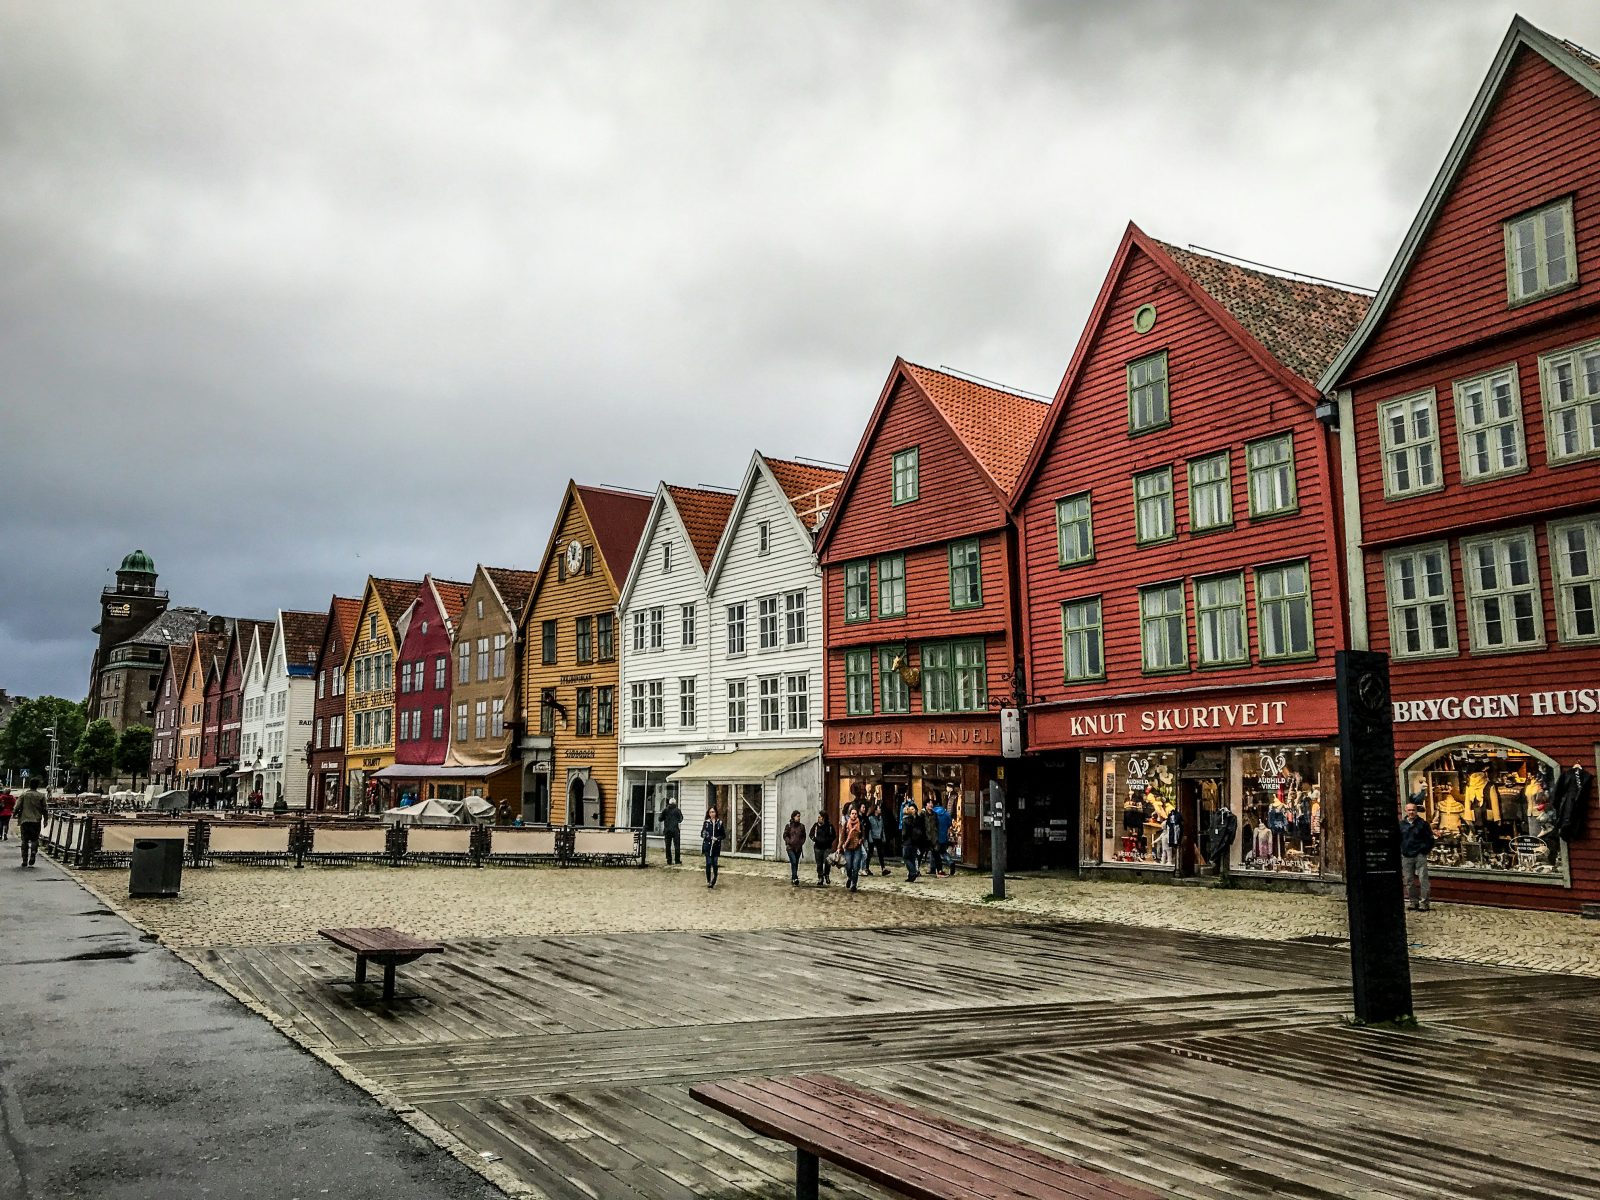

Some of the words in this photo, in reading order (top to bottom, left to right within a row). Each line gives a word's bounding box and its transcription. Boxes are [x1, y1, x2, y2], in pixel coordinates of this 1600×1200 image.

[1070, 712, 1127, 736] KNUT
[1141, 701, 1288, 731] SKURTVEIT
[1392, 694, 1520, 723] BRYGGEN
[1530, 688, 1600, 716] HUS
[838, 729, 903, 745] BRYGGEN
[927, 728, 994, 745] HANDEL
